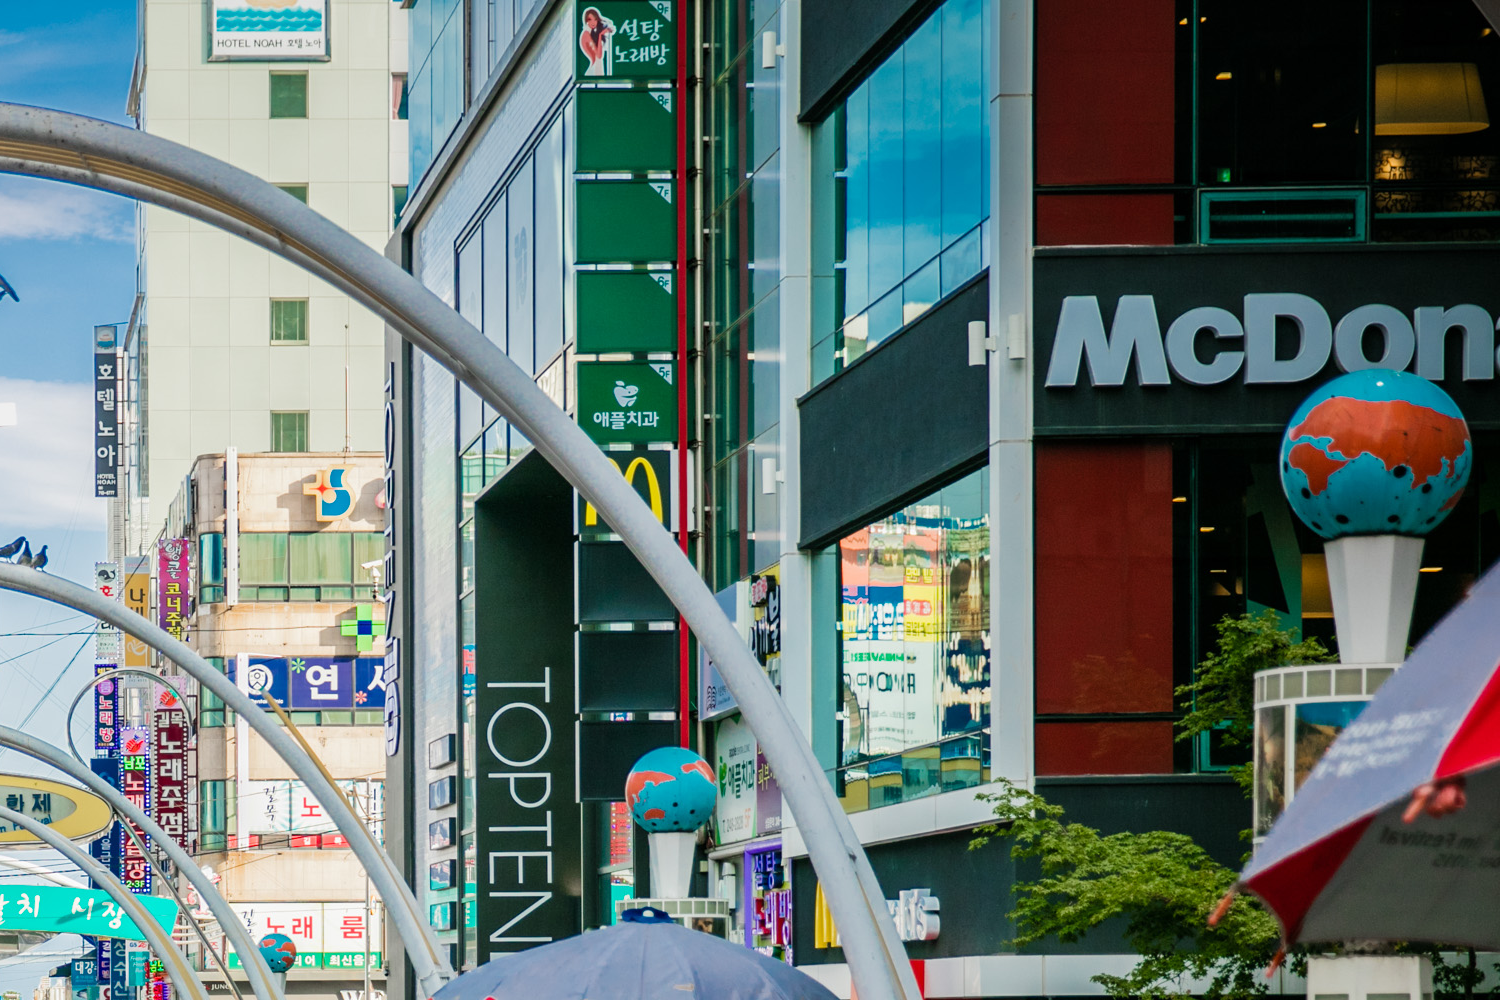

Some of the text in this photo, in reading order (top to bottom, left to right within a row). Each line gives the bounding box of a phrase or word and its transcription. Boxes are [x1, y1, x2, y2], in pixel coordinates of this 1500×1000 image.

[619, 19, 664, 41] 설탕
[217, 38, 321, 49] HOTEL NOAH 호텔 노아
[615, 43, 670, 65] 노래방
[1044, 293, 1500, 388] McDon
[658, 367, 670, 378] 5F
[593, 411, 659, 430] 애플치과
[99, 695, 114, 743] 노래방
[160, 731, 183, 836] 노래주점
[486, 666, 554, 960] TOPTEN
[71, 896, 127, 930] 시장
[264, 915, 366, 940] 노래 룸
[74, 961, 97, 975] 대강
